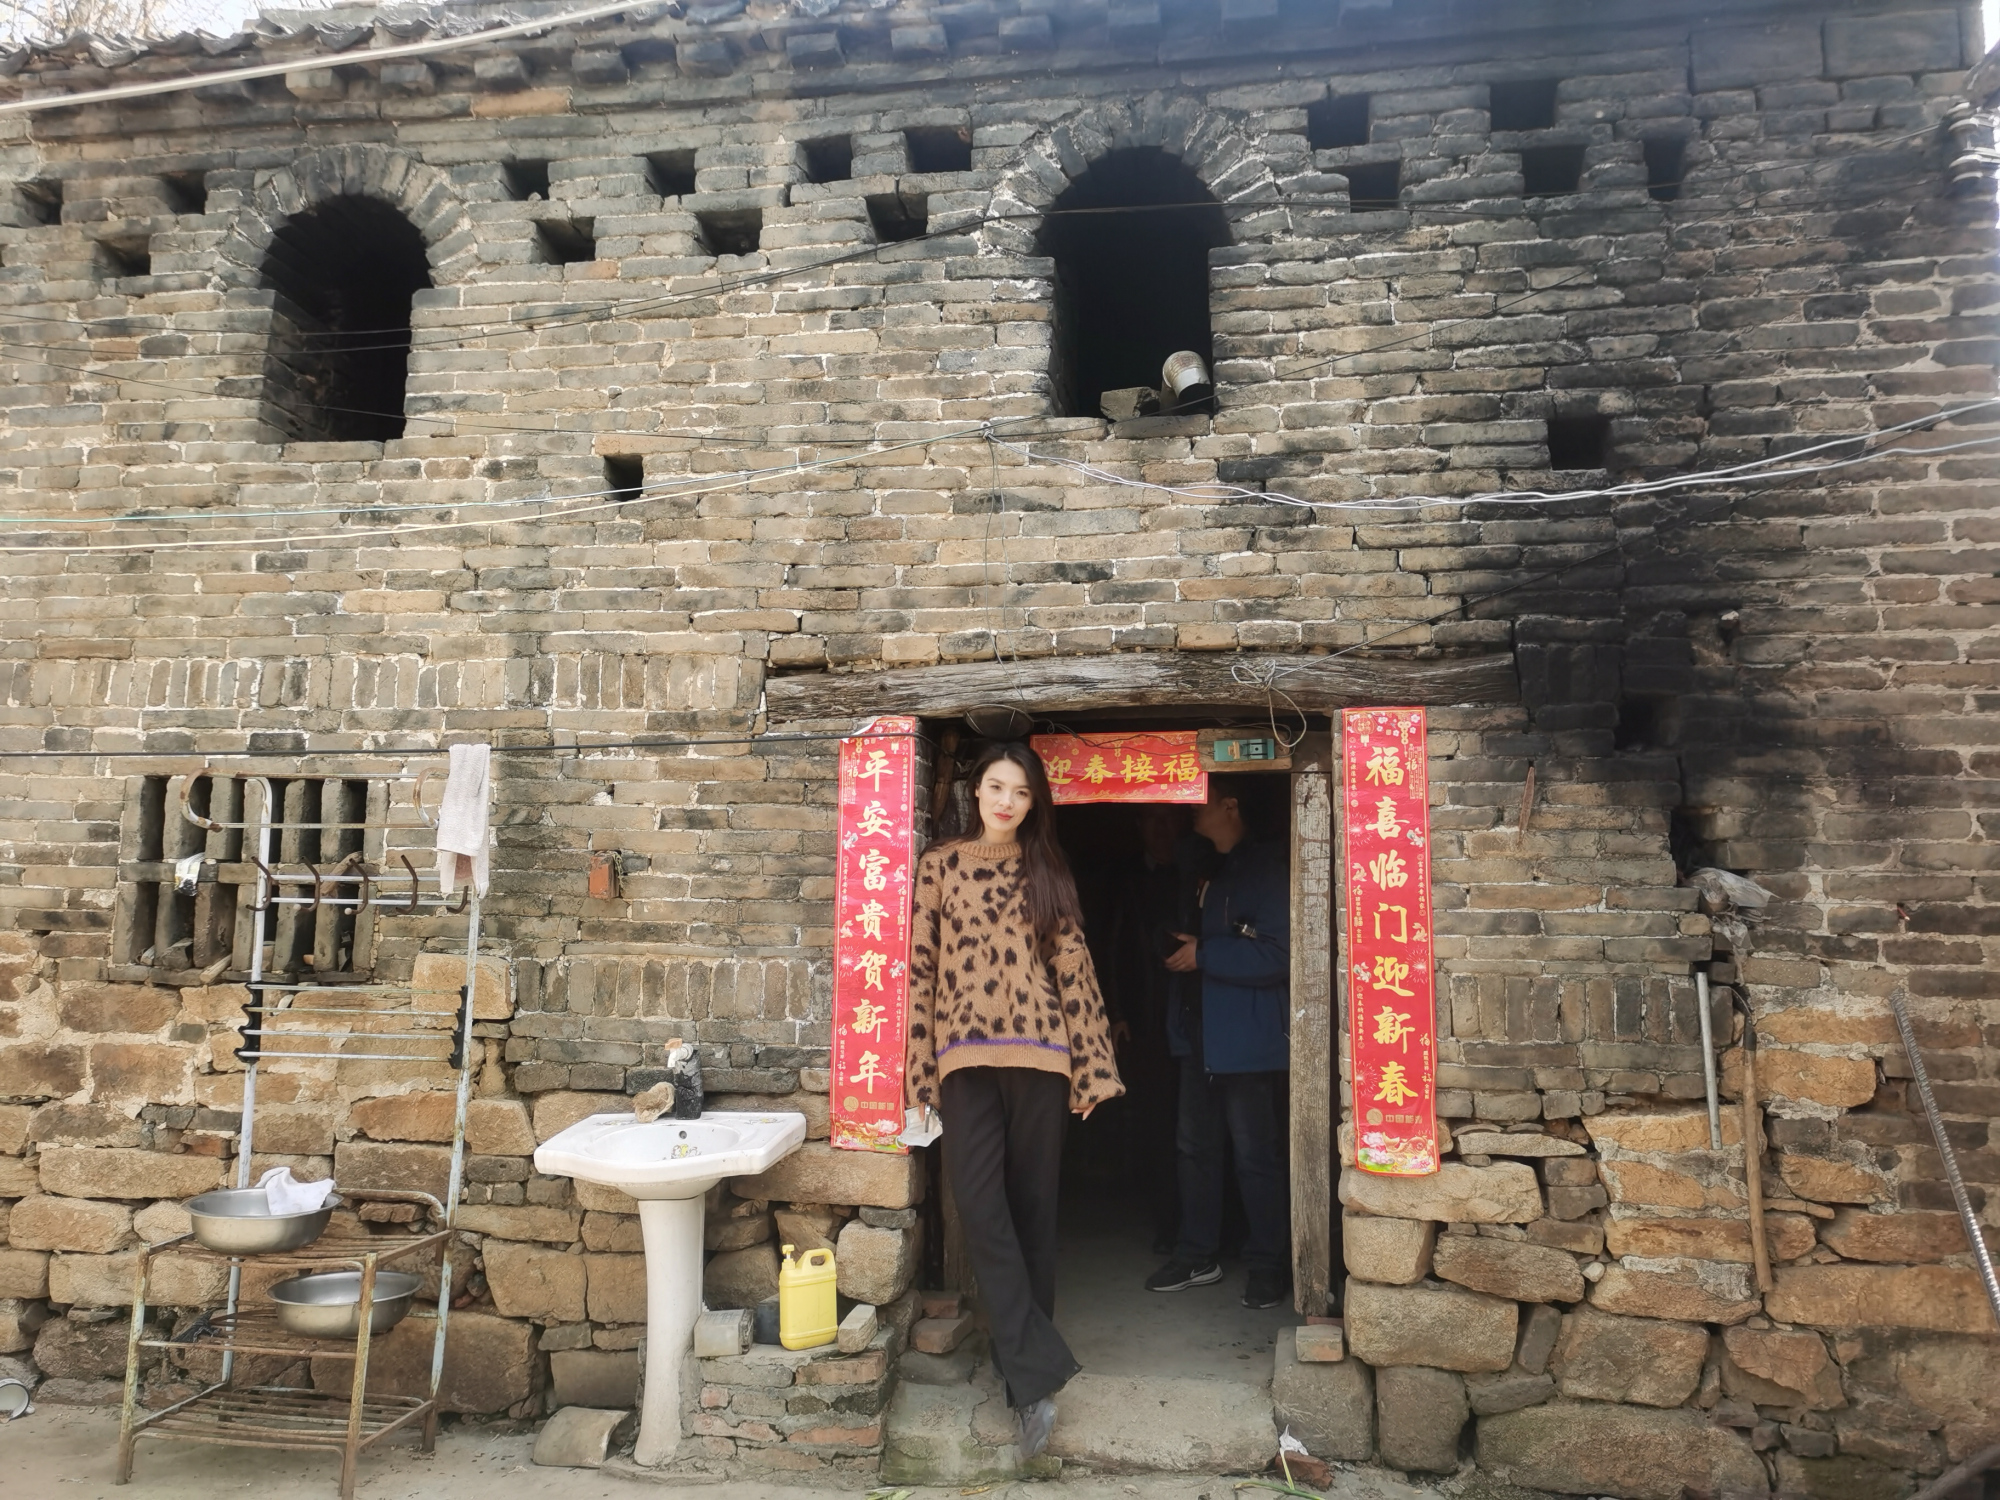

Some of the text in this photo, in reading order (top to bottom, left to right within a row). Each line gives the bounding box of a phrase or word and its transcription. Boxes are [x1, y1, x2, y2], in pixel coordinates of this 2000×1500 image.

[850, 749, 894, 1094] 平安富贵贺新年
[1043, 753, 1200, 785] 迎春接福
[1365, 746, 1418, 1106] 福喜临门迎新春
